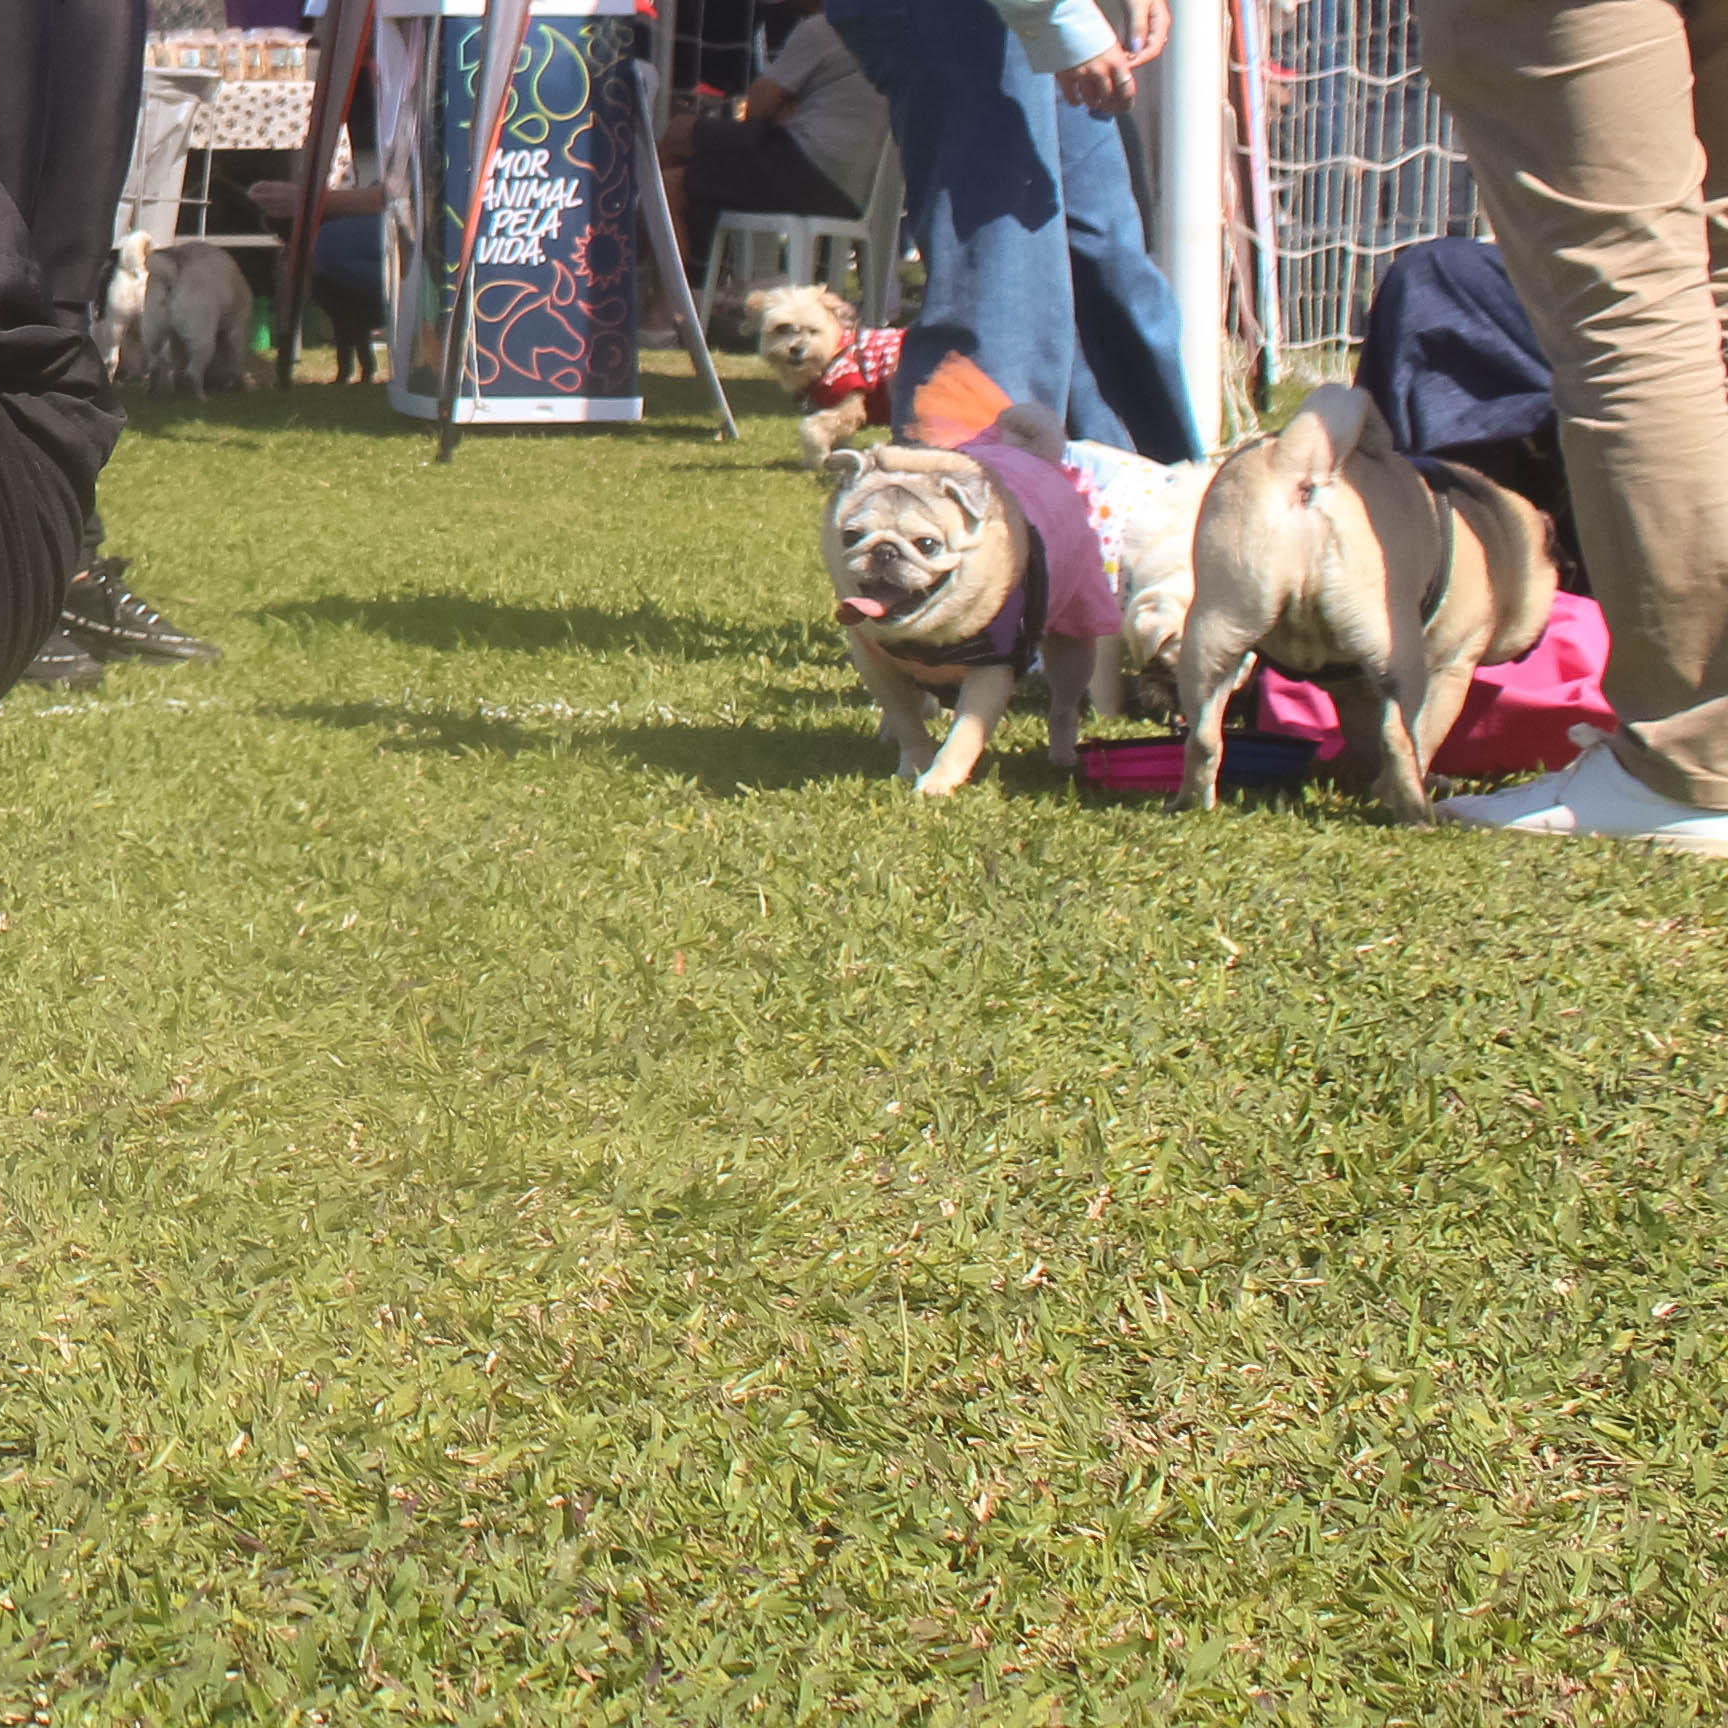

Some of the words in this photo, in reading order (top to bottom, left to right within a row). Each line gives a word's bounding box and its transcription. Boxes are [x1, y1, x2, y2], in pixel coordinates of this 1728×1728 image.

[488, 148, 550, 179] MOR
[481, 177, 584, 211] ANIMAL
[489, 208, 562, 240] PELA
[476, 235, 547, 266] VIDA.
